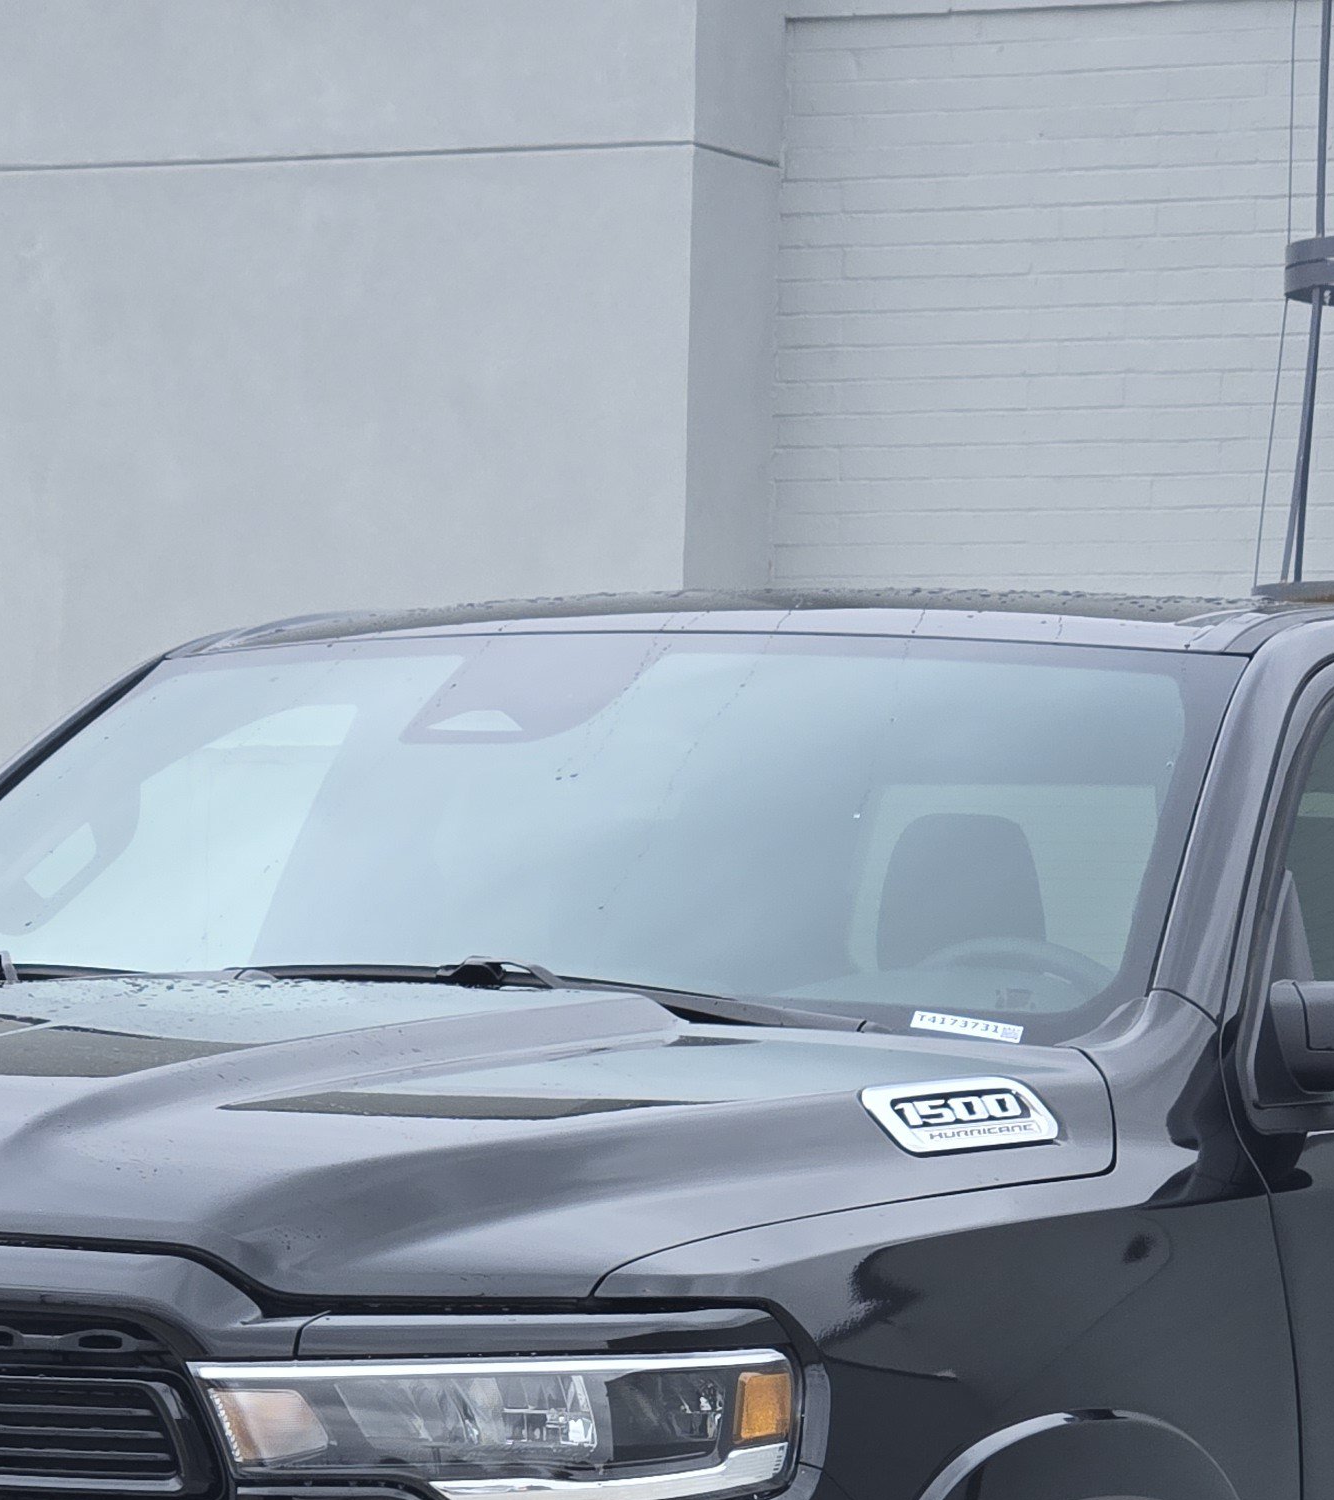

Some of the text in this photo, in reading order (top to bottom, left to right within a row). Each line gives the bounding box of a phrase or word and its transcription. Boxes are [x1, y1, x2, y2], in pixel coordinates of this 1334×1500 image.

[917, 1013, 999, 1034] T4173731
[894, 1093, 1022, 1126] 1500
[929, 1124, 1034, 1140] HURRICANE
